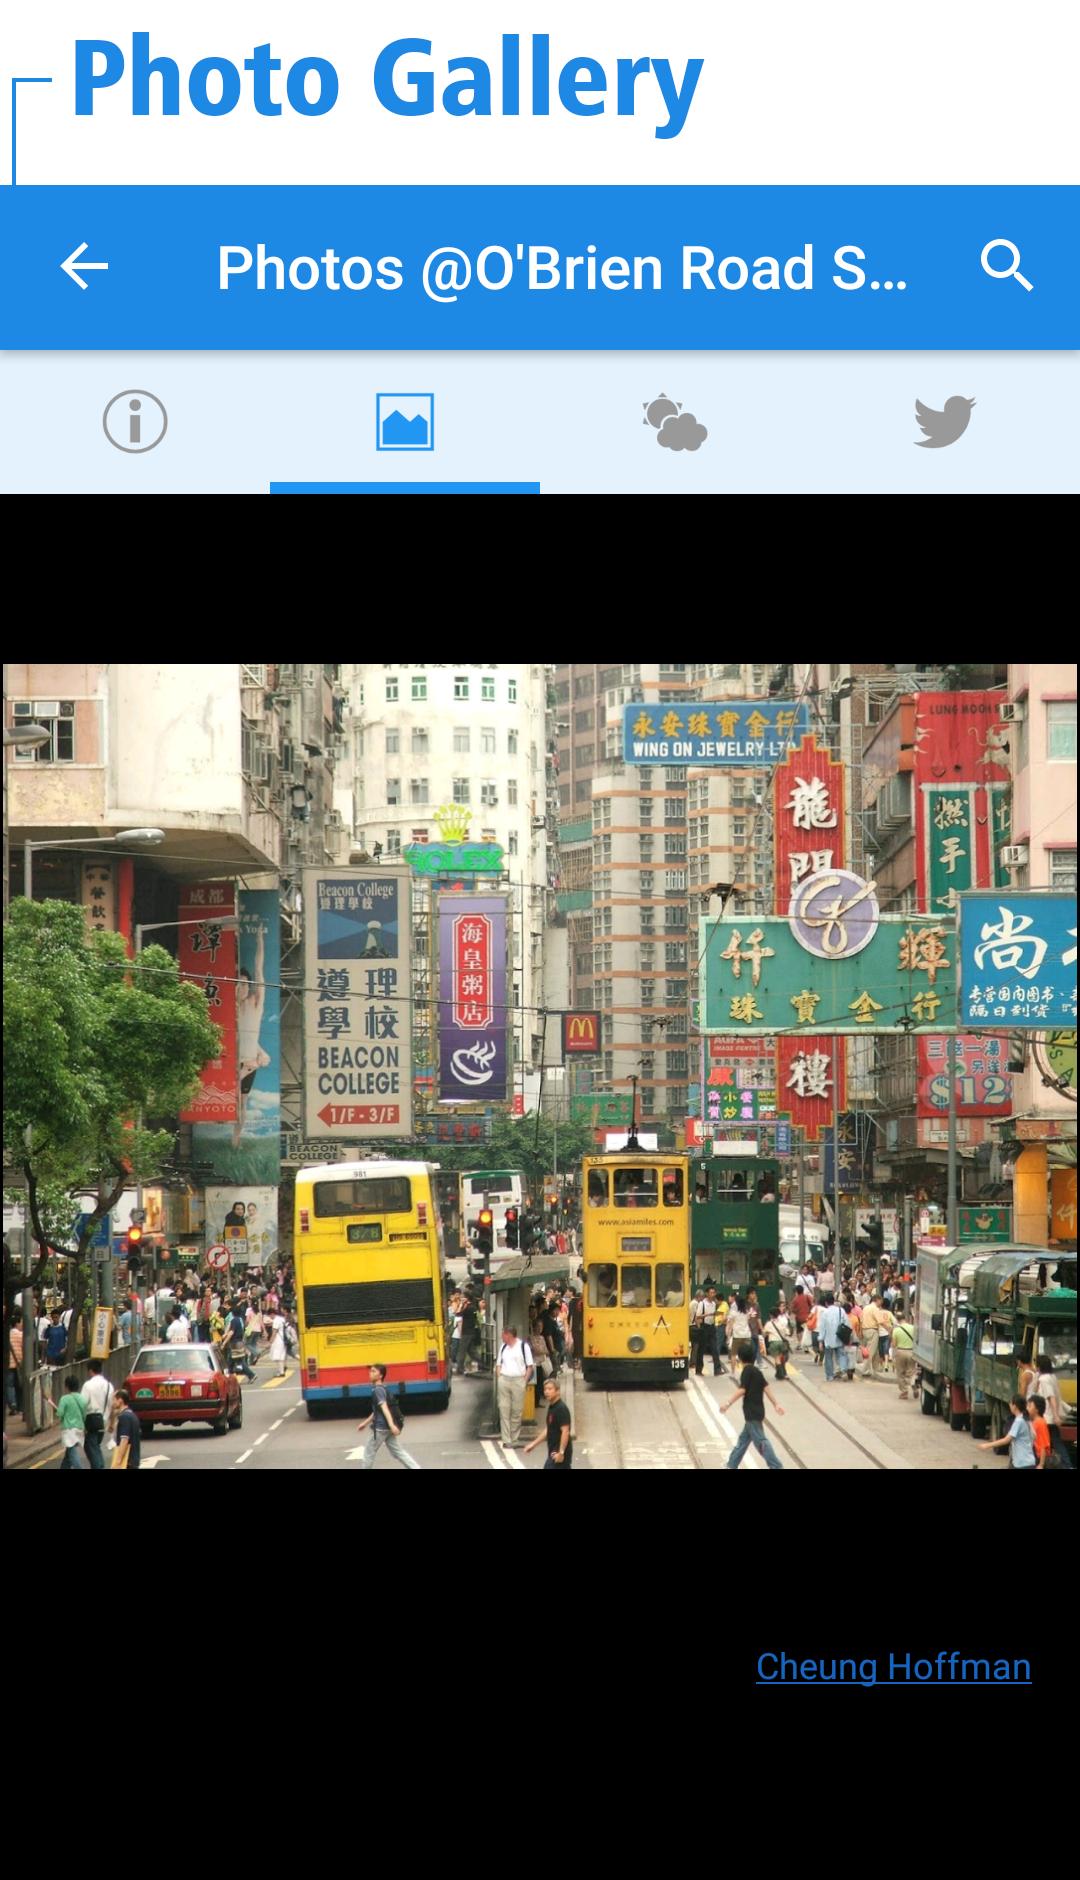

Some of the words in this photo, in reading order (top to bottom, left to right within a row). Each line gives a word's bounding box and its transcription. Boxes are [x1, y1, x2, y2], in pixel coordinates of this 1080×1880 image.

[930, 704, 958, 714] LUNG
[632, 710, 799, 737] 永安珠寶金行
[633, 741, 669, 757] WING
[673, 741, 693, 757] ON
[697, 741, 764, 757] JEWELRY
[318, 882, 354, 898] Beacon
[357, 882, 395, 899] College
[246, 925, 269, 935] Yoa
[973, 906, 1077, 980] 尚
[460, 922, 484, 1022] 海皇粥店
[317, 967, 398, 1001] 遵理
[729, 990, 942, 1024] 珠寶金行
[317, 1005, 399, 1040] 學校
[317, 1046, 399, 1070] BEACON
[317, 1071, 400, 1097] COLLEGE
[183, 1104, 236, 1113] ANYOTO
[330, 1107, 355, 1123] 1/F
[368, 1107, 395, 1122] 3/F
[289, 1144, 338, 1153] BEACON
[289, 1152, 338, 1160] COLLEGE
[598, 1218, 675, 1226] www.asiamiles.com
